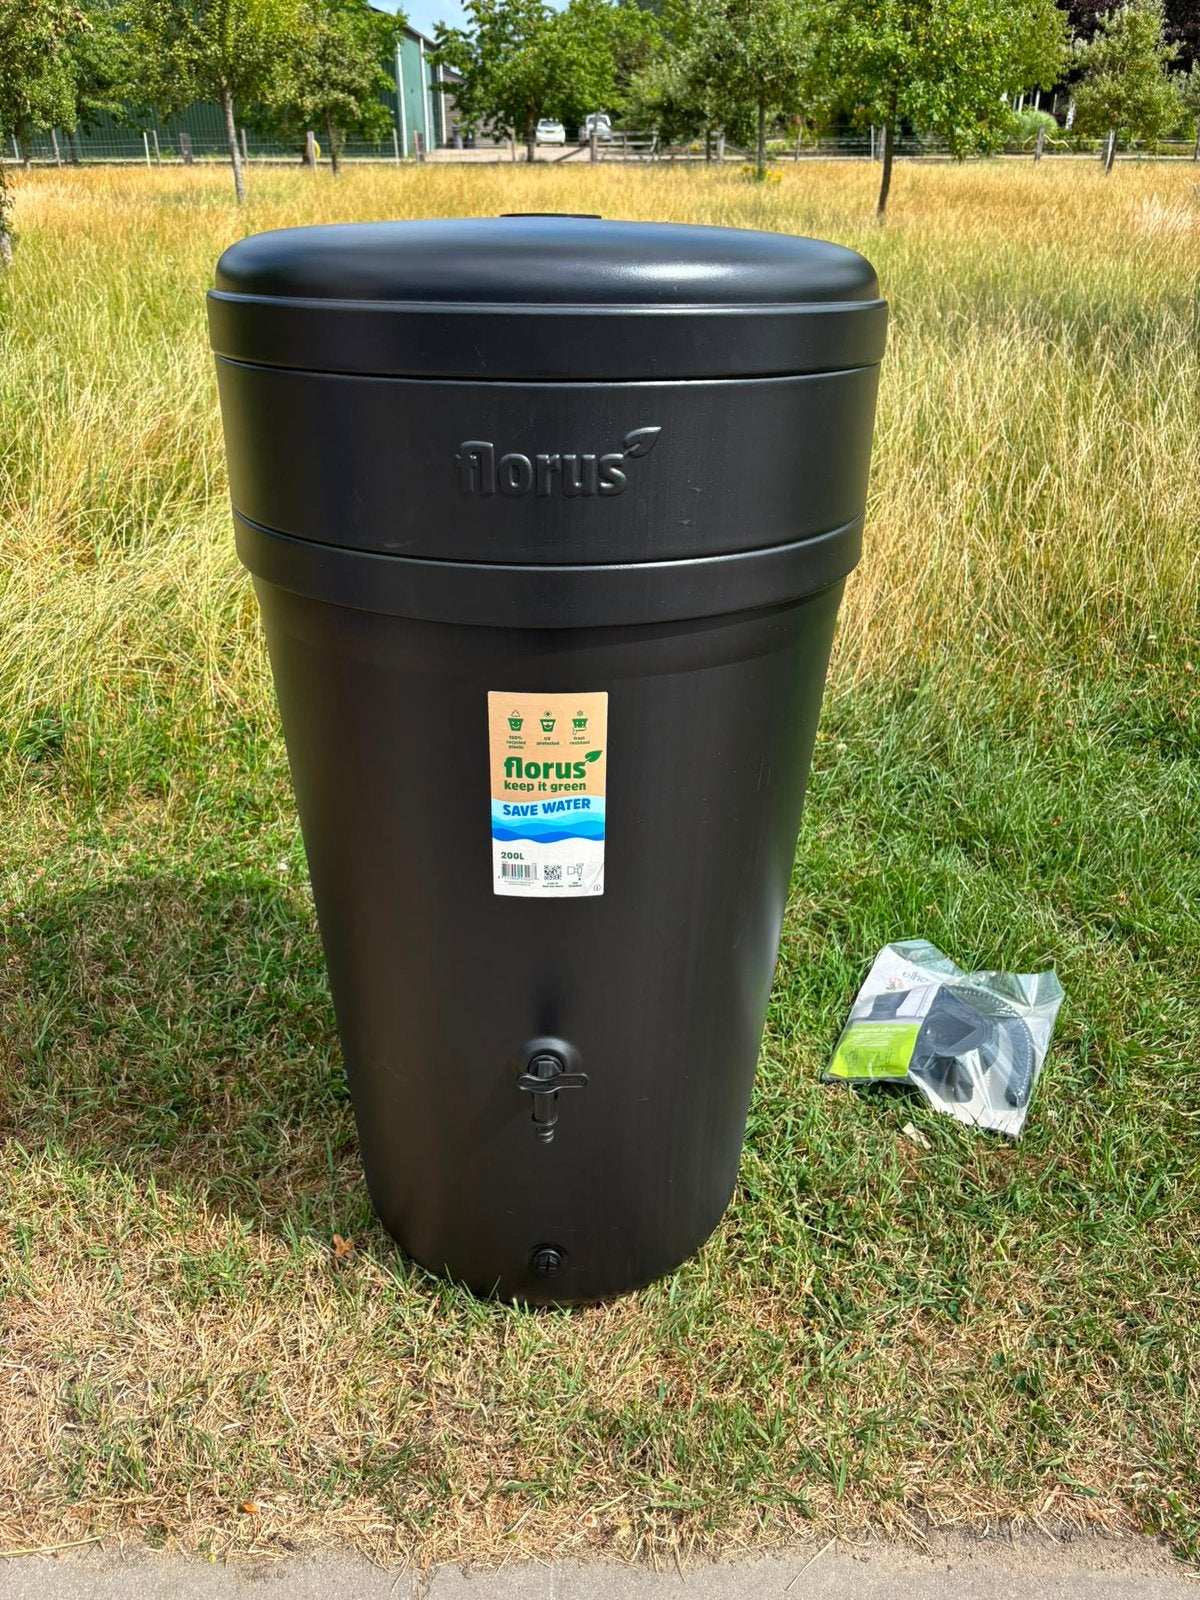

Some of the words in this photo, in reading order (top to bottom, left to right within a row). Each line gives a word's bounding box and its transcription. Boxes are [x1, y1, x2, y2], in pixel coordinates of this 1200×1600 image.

[454, 440, 628, 497] florus
[503, 756, 587, 780] florus
[504, 780, 535, 793] keep
[537, 781, 548, 792] it
[550, 782, 587, 793] green
[502, 804, 539, 817] SAVE
[541, 798, 591, 814] WATER
[500, 851, 525, 861] 200L
